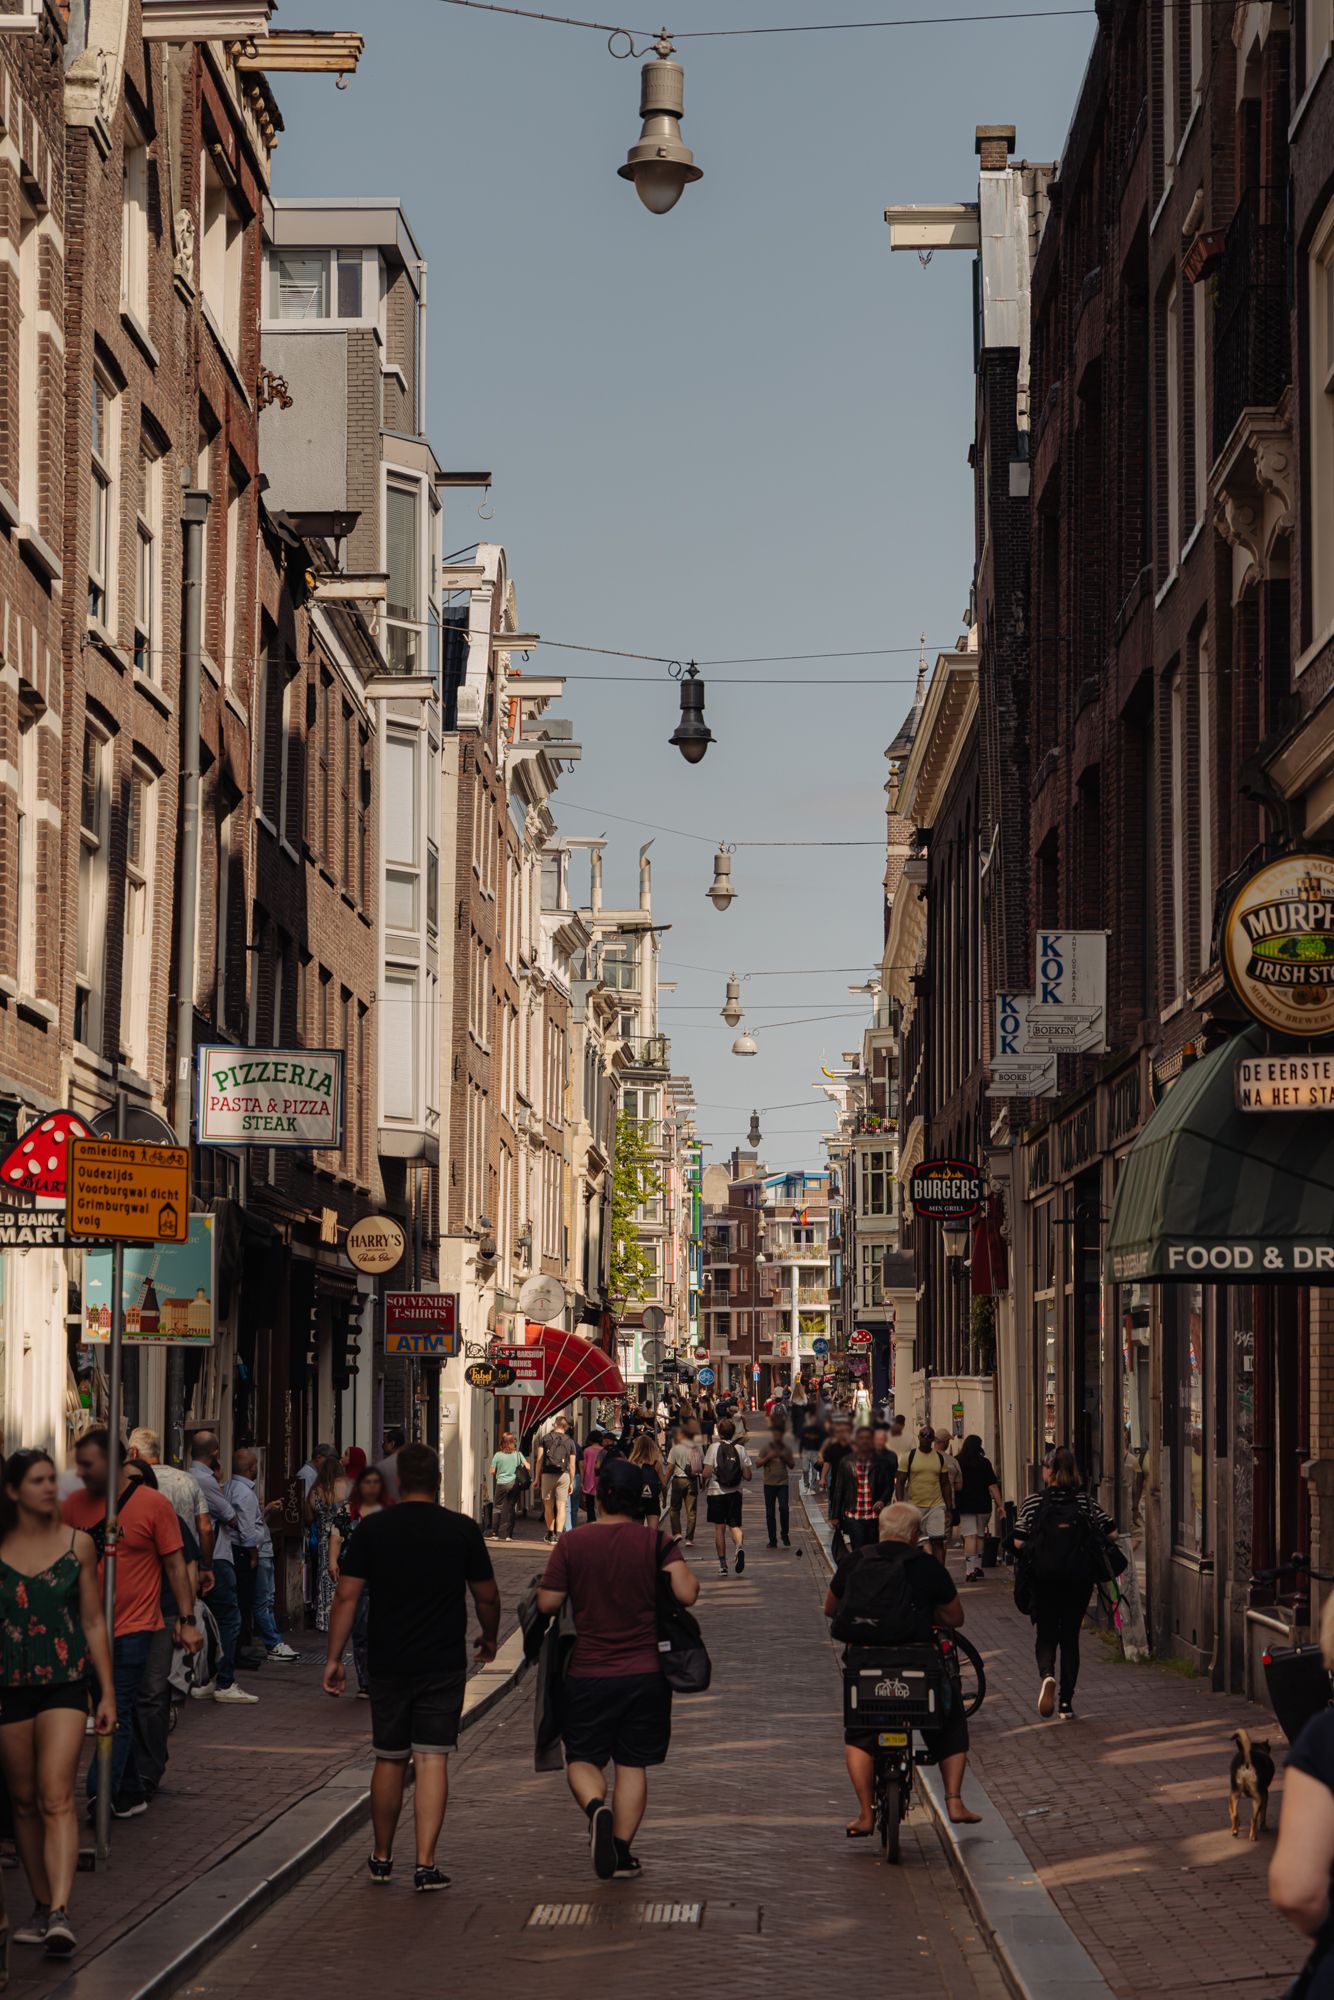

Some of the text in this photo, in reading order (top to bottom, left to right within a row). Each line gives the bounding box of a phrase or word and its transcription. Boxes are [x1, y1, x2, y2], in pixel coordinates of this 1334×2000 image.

[1040, 936, 1064, 1004] KOK
[1255, 960, 1305, 983] IRISH
[1249, 984, 1283, 1018] MURPHY
[1000, 993, 1020, 1054] KOK
[1035, 1026, 1074, 1036] BOEKEN
[212, 1062, 334, 1097] PIZZERIA
[998, 1073, 1027, 1081] BOOKS
[1242, 1062, 1331, 1082] DE EERSTE
[1243, 1088, 1262, 1106] NA
[1272, 1087, 1301, 1105] HET
[210, 1096, 331, 1116] PASTA & PIZZA
[242, 1115, 297, 1132] STEAK
[80, 1144, 136, 1161] omleiding
[78, 1166, 133, 1183] Oudezijds
[78, 1182, 179, 1200] Voorburgwal dicht
[914, 1179, 980, 1200] BURGERS
[77, 1198, 149, 1215] Grimburgwal
[18, 1213, 59, 1226] BANK
[77, 1215, 101, 1229] volg
[351, 1233, 402, 1248] HARRY'S
[1168, 1246, 1254, 1269] FOOD
[1262, 1246, 1285, 1269] &
[1293, 1246, 1334, 1269] DR
[386, 1296, 453, 1307] SOUVENIRS
[393, 1308, 447, 1319] T-SHIRTS
[396, 1334, 448, 1352] ATM
[508, 1360, 532, 1368] DRINKS
[516, 1369, 537, 1377] CARDS
